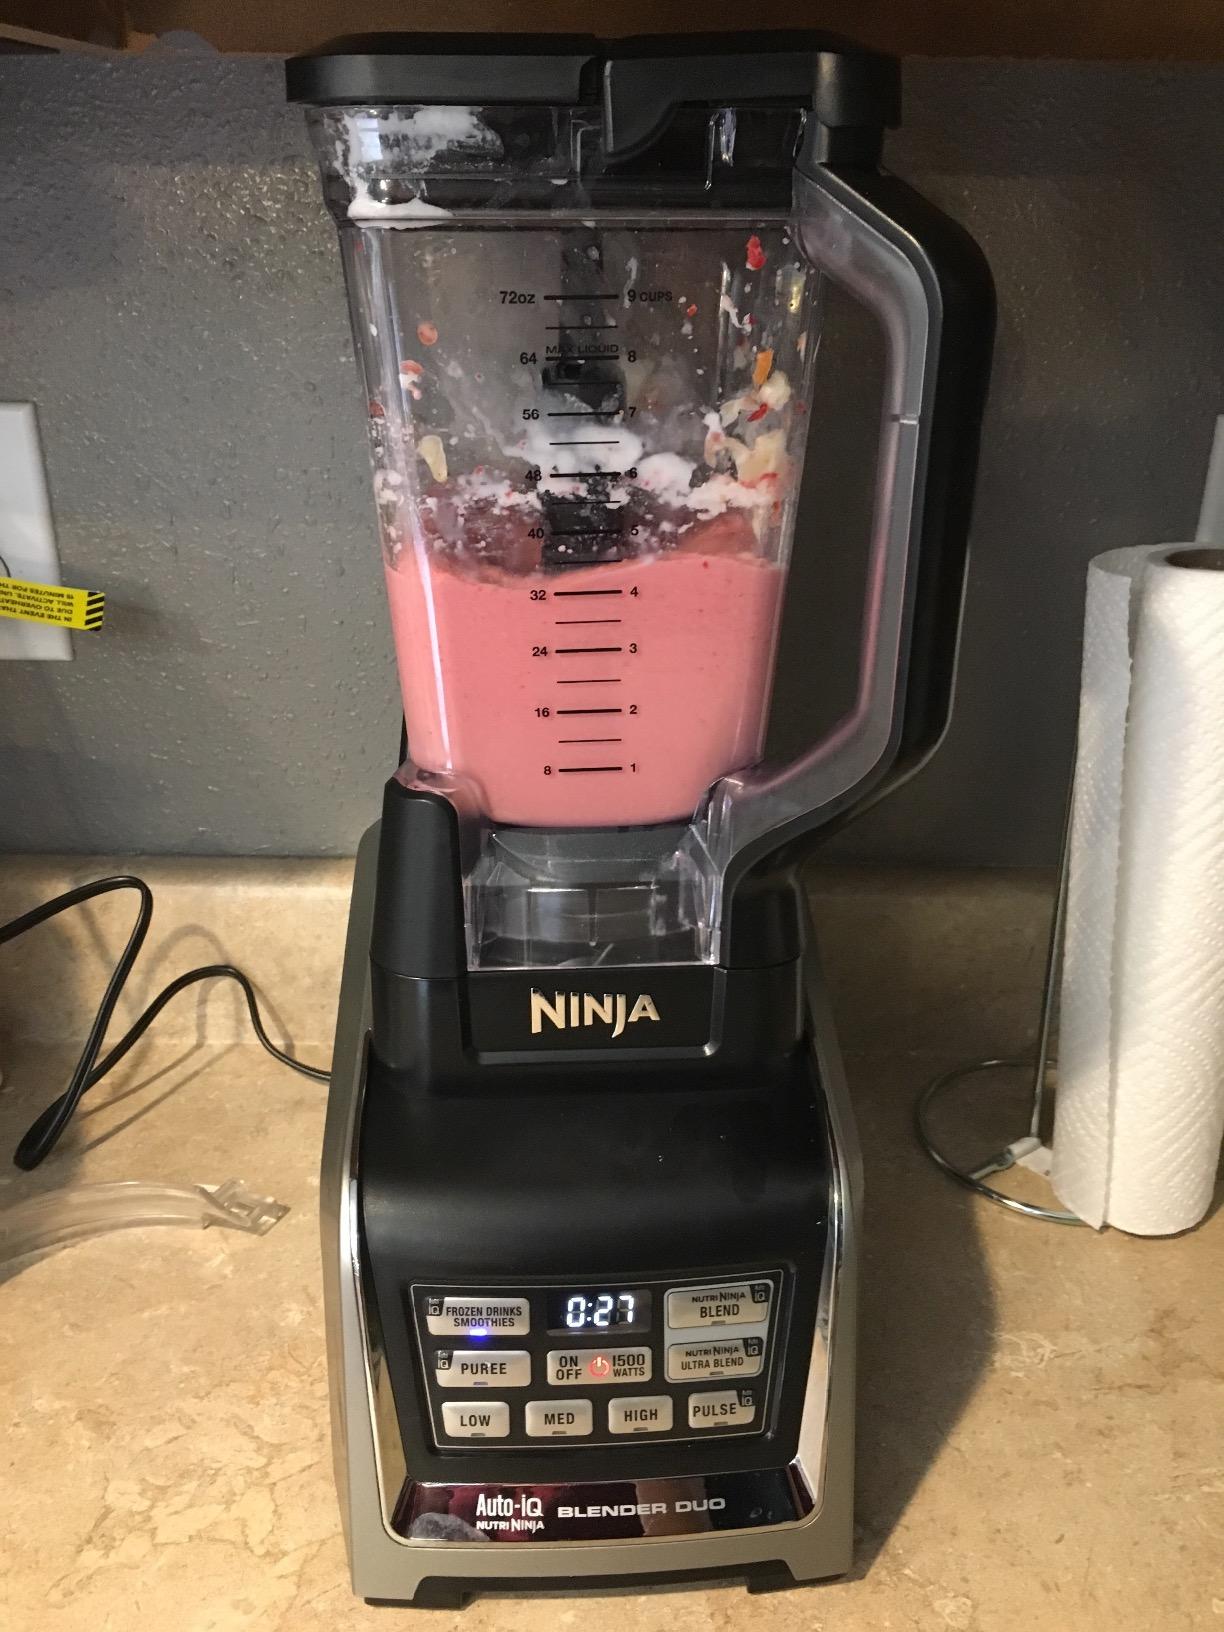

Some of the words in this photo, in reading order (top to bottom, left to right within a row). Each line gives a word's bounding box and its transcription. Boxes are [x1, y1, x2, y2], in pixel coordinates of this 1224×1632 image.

[500, 291, 536, 304] 72oz
[628, 289, 636, 302] 9
[640, 291, 672, 302] CUPS
[578, 344, 619, 353] LIQUID
[520, 352, 537, 364] 64
[628, 352, 636, 363] 8
[522, 409, 539, 420] 56
[629, 407, 637, 418] 7
[525, 470, 542, 482] 48
[629, 467, 638, 478] 6
[528, 528, 544, 539] 40
[631, 526, 639, 536] 5
[29, 588, 65, 598] MINUTES
[530, 590, 546, 600] 32
[630, 586, 638, 597] 4
[20, 609, 45, 618] EVENT
[44, 605, 54, 613] TO
[56, 607, 73, 615] DUE
[532, 646, 548, 656] 24
[629, 643, 637, 653] 3
[534, 707, 550, 718] 16
[629, 705, 638, 714] 2
[544, 766, 551, 775] 8
[630, 763, 636, 772] 1
[530, 987, 661, 1038] NINJA
[692, 1294, 718, 1304] NUTRI
[719, 1291, 746, 1302] NINJA
[446, 1306, 483, 1316] FROZEN
[486, 1306, 522, 1316] DRINKS
[566, 1294, 634, 1327] 0:27
[700, 1304, 740, 1318] BLEND
[454, 1318, 515, 1327] SMOOTHIES
[685, 1349, 711, 1358] NUTRI
[713, 1346, 739, 1357] NINJA
[559, 1356, 578, 1368] ON
[612, 1354, 645, 1366] 1500
[681, 1359, 710, 1371] ULTRA
[713, 1356, 744, 1368] BLEND
[461, 1363, 507, 1374] PUREE
[556, 1368, 582, 1380] OFF
[613, 1367, 645, 1378] WATTS
[624, 1408, 658, 1422] HIGH
[693, 1402, 737, 1417] PULSE
[460, 1415, 491, 1427] LOW
[544, 1413, 575, 1425] MED
[476, 1493, 544, 1517] Auto-iQ
[557, 1503, 667, 1518] BLENDER
[675, 1498, 726, 1513] DUO
[476, 1520, 509, 1530] NUTRI
[511, 1518, 545, 1534] NINJA
